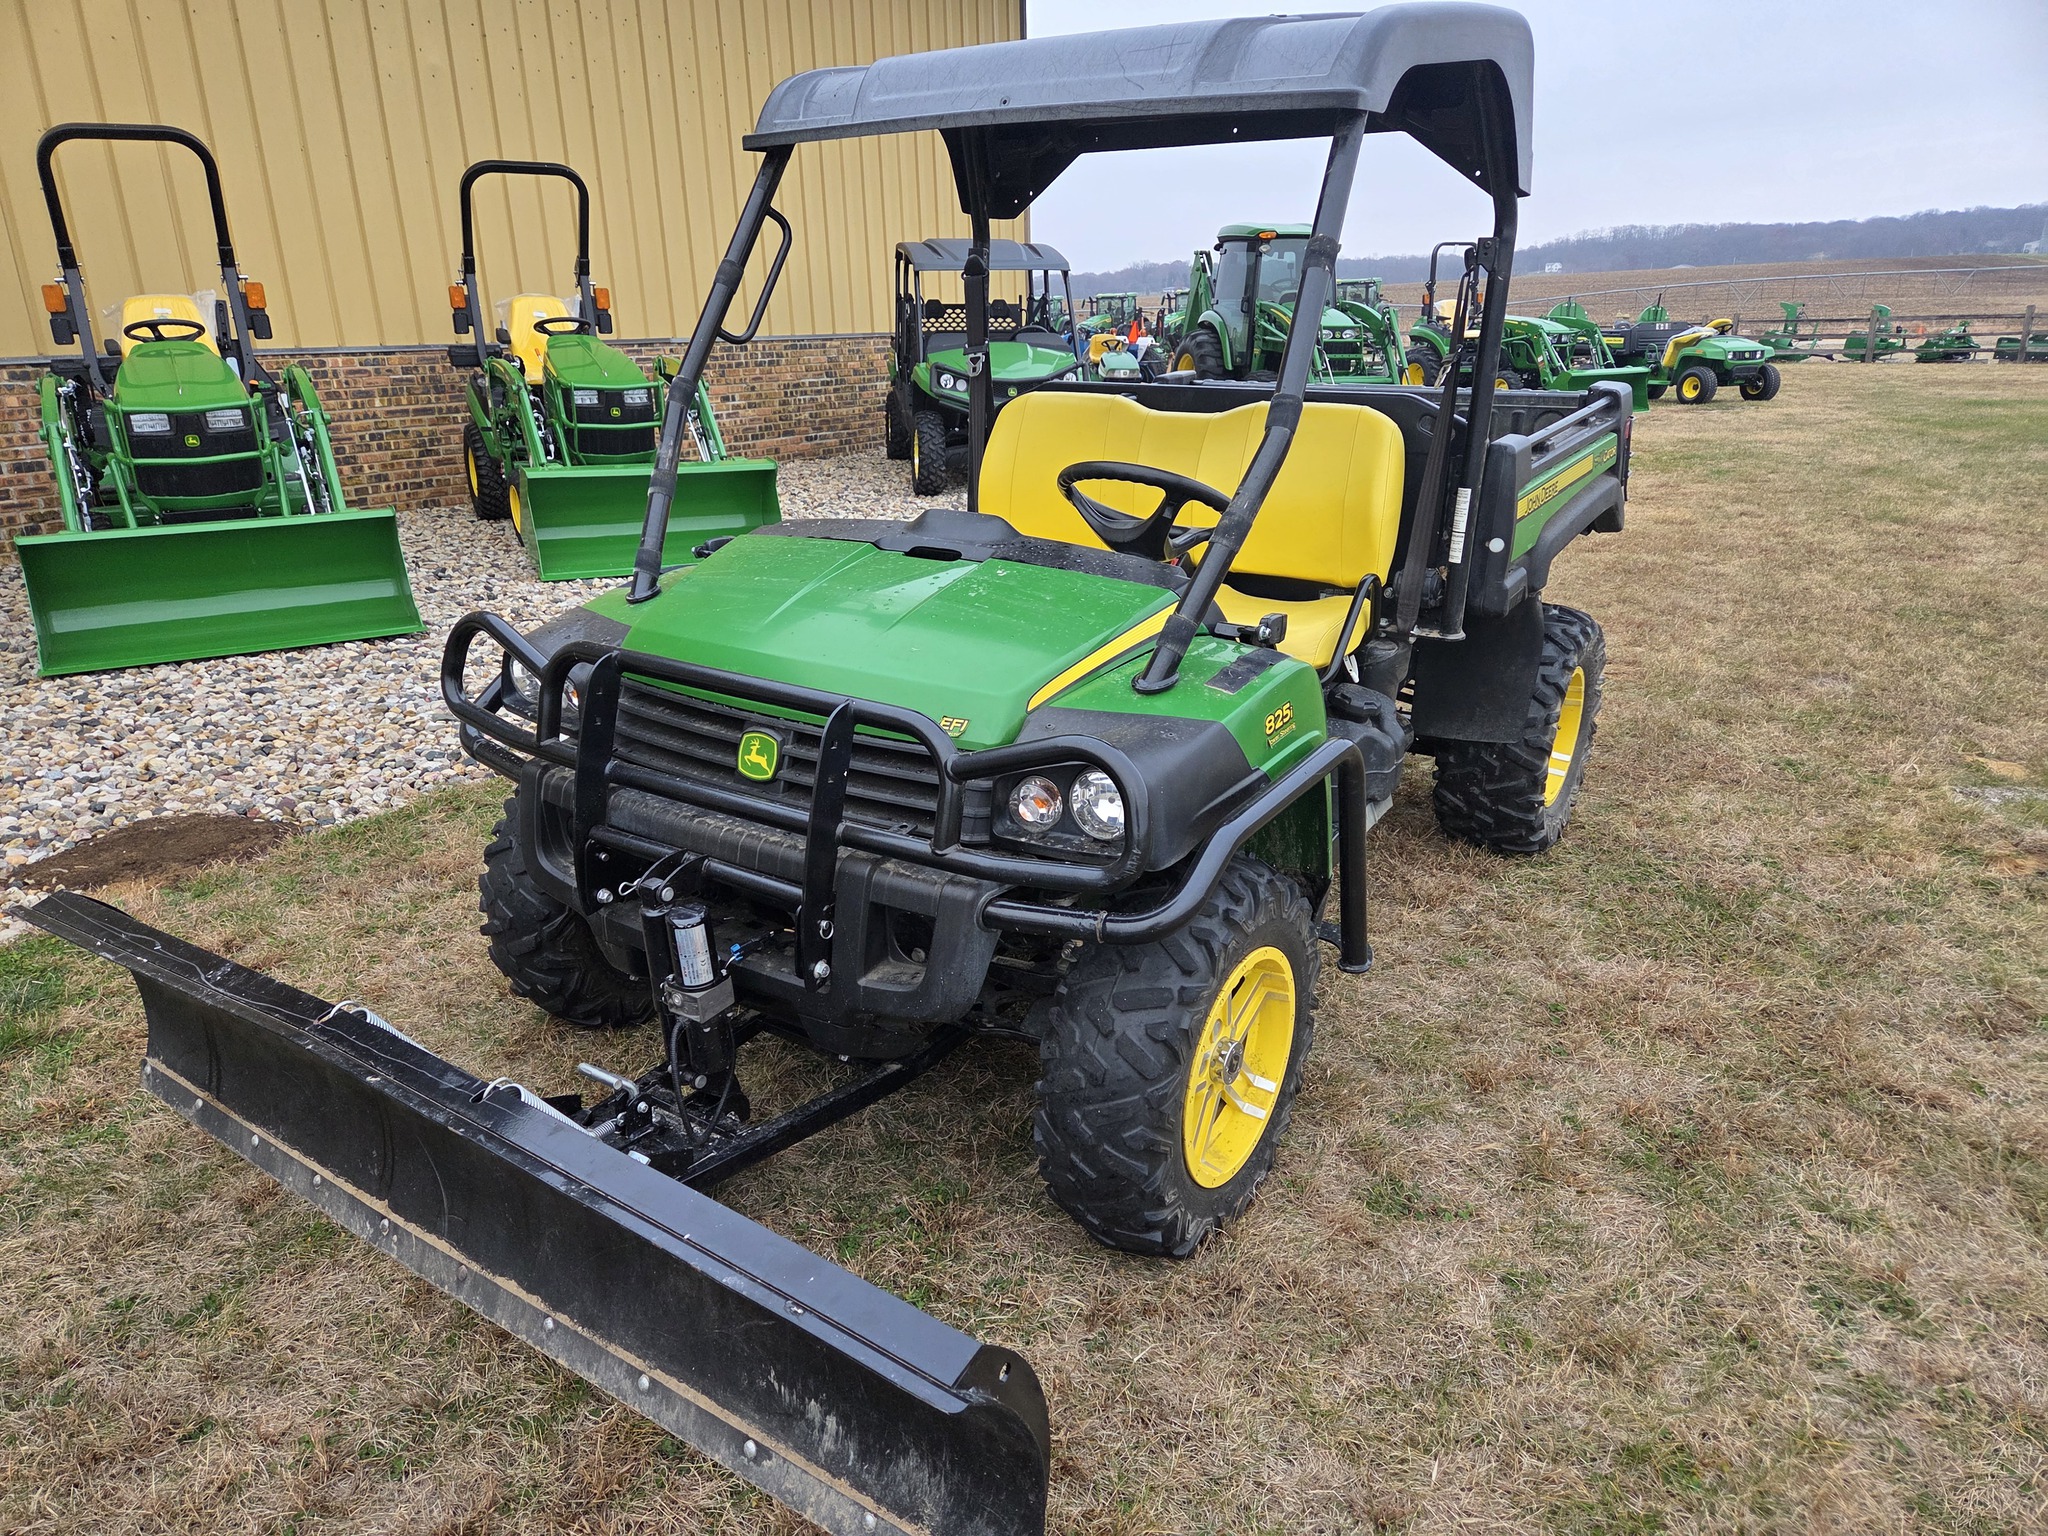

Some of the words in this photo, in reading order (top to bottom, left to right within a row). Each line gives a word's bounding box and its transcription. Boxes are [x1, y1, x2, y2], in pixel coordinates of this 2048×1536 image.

[1525, 490, 1543, 516] JOHN
[1541, 480, 1560, 504] DEERE
[939, 716, 969, 732] EFI
[1265, 701, 1293, 736] 825i
